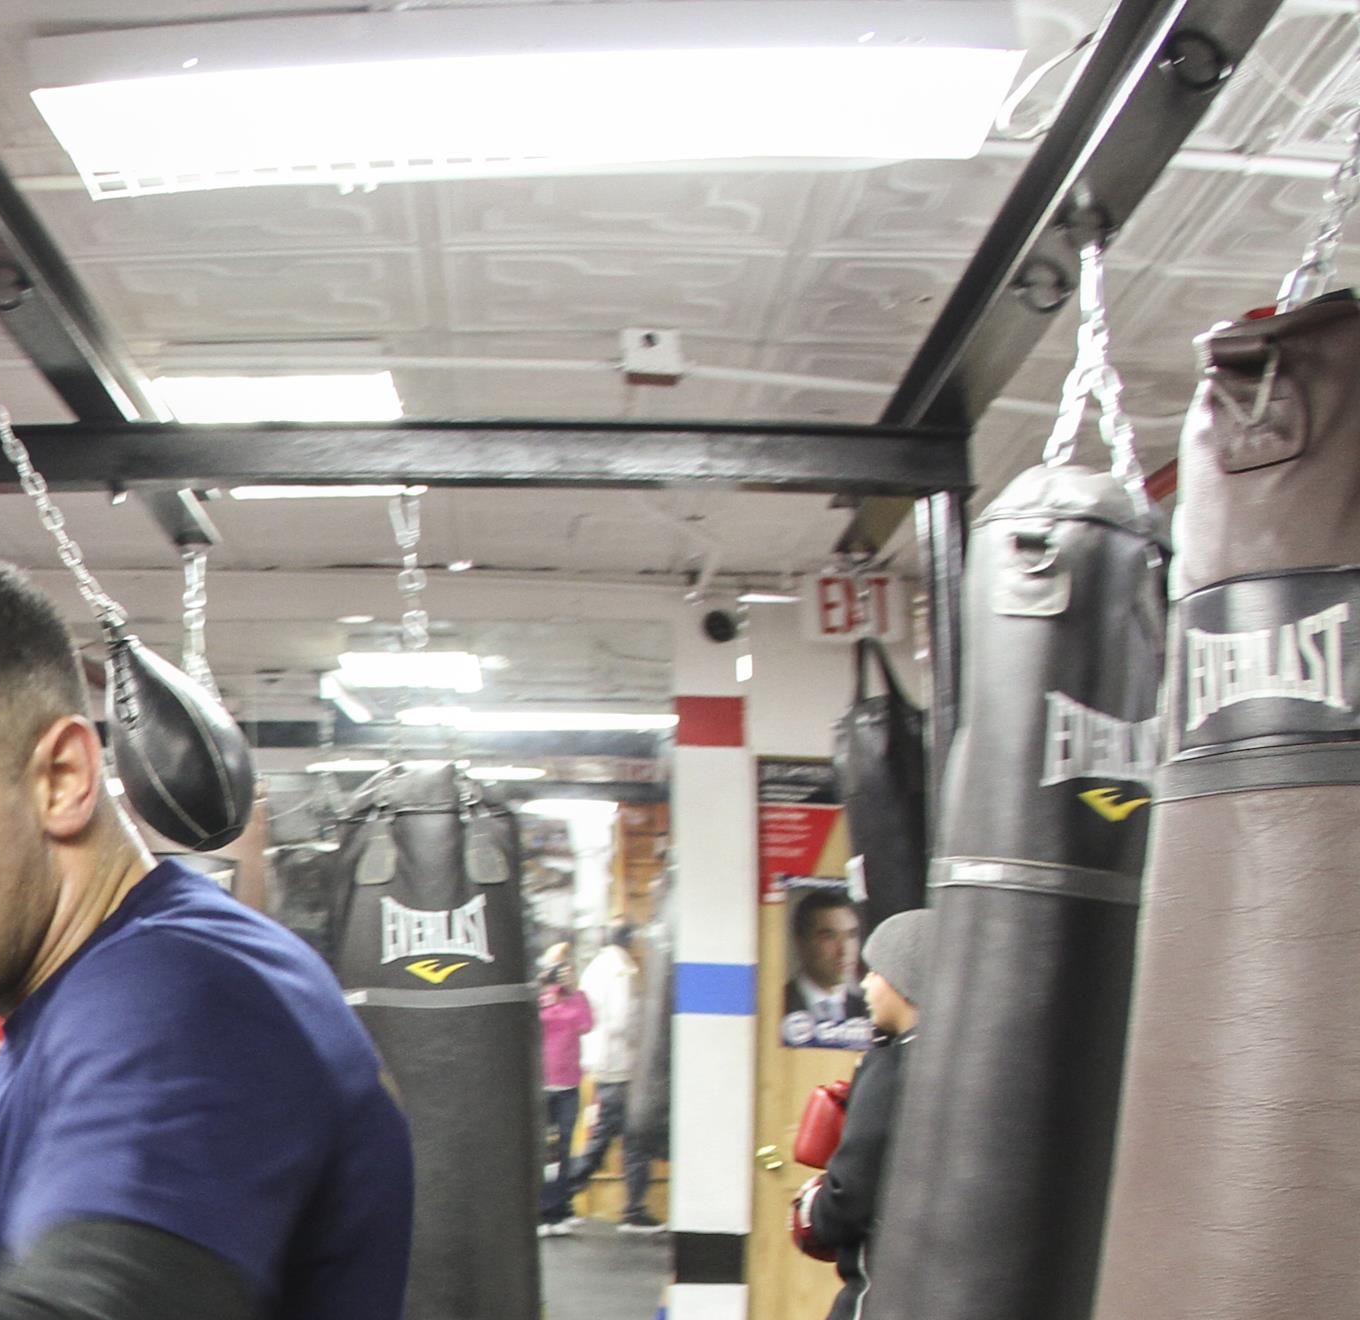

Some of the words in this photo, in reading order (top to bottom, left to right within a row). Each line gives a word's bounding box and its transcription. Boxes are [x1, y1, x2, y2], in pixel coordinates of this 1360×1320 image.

[818, 577, 889, 634] EXT
[1185, 602, 1352, 732] EVERLAST
[380, 893, 495, 964] EVERLAST
